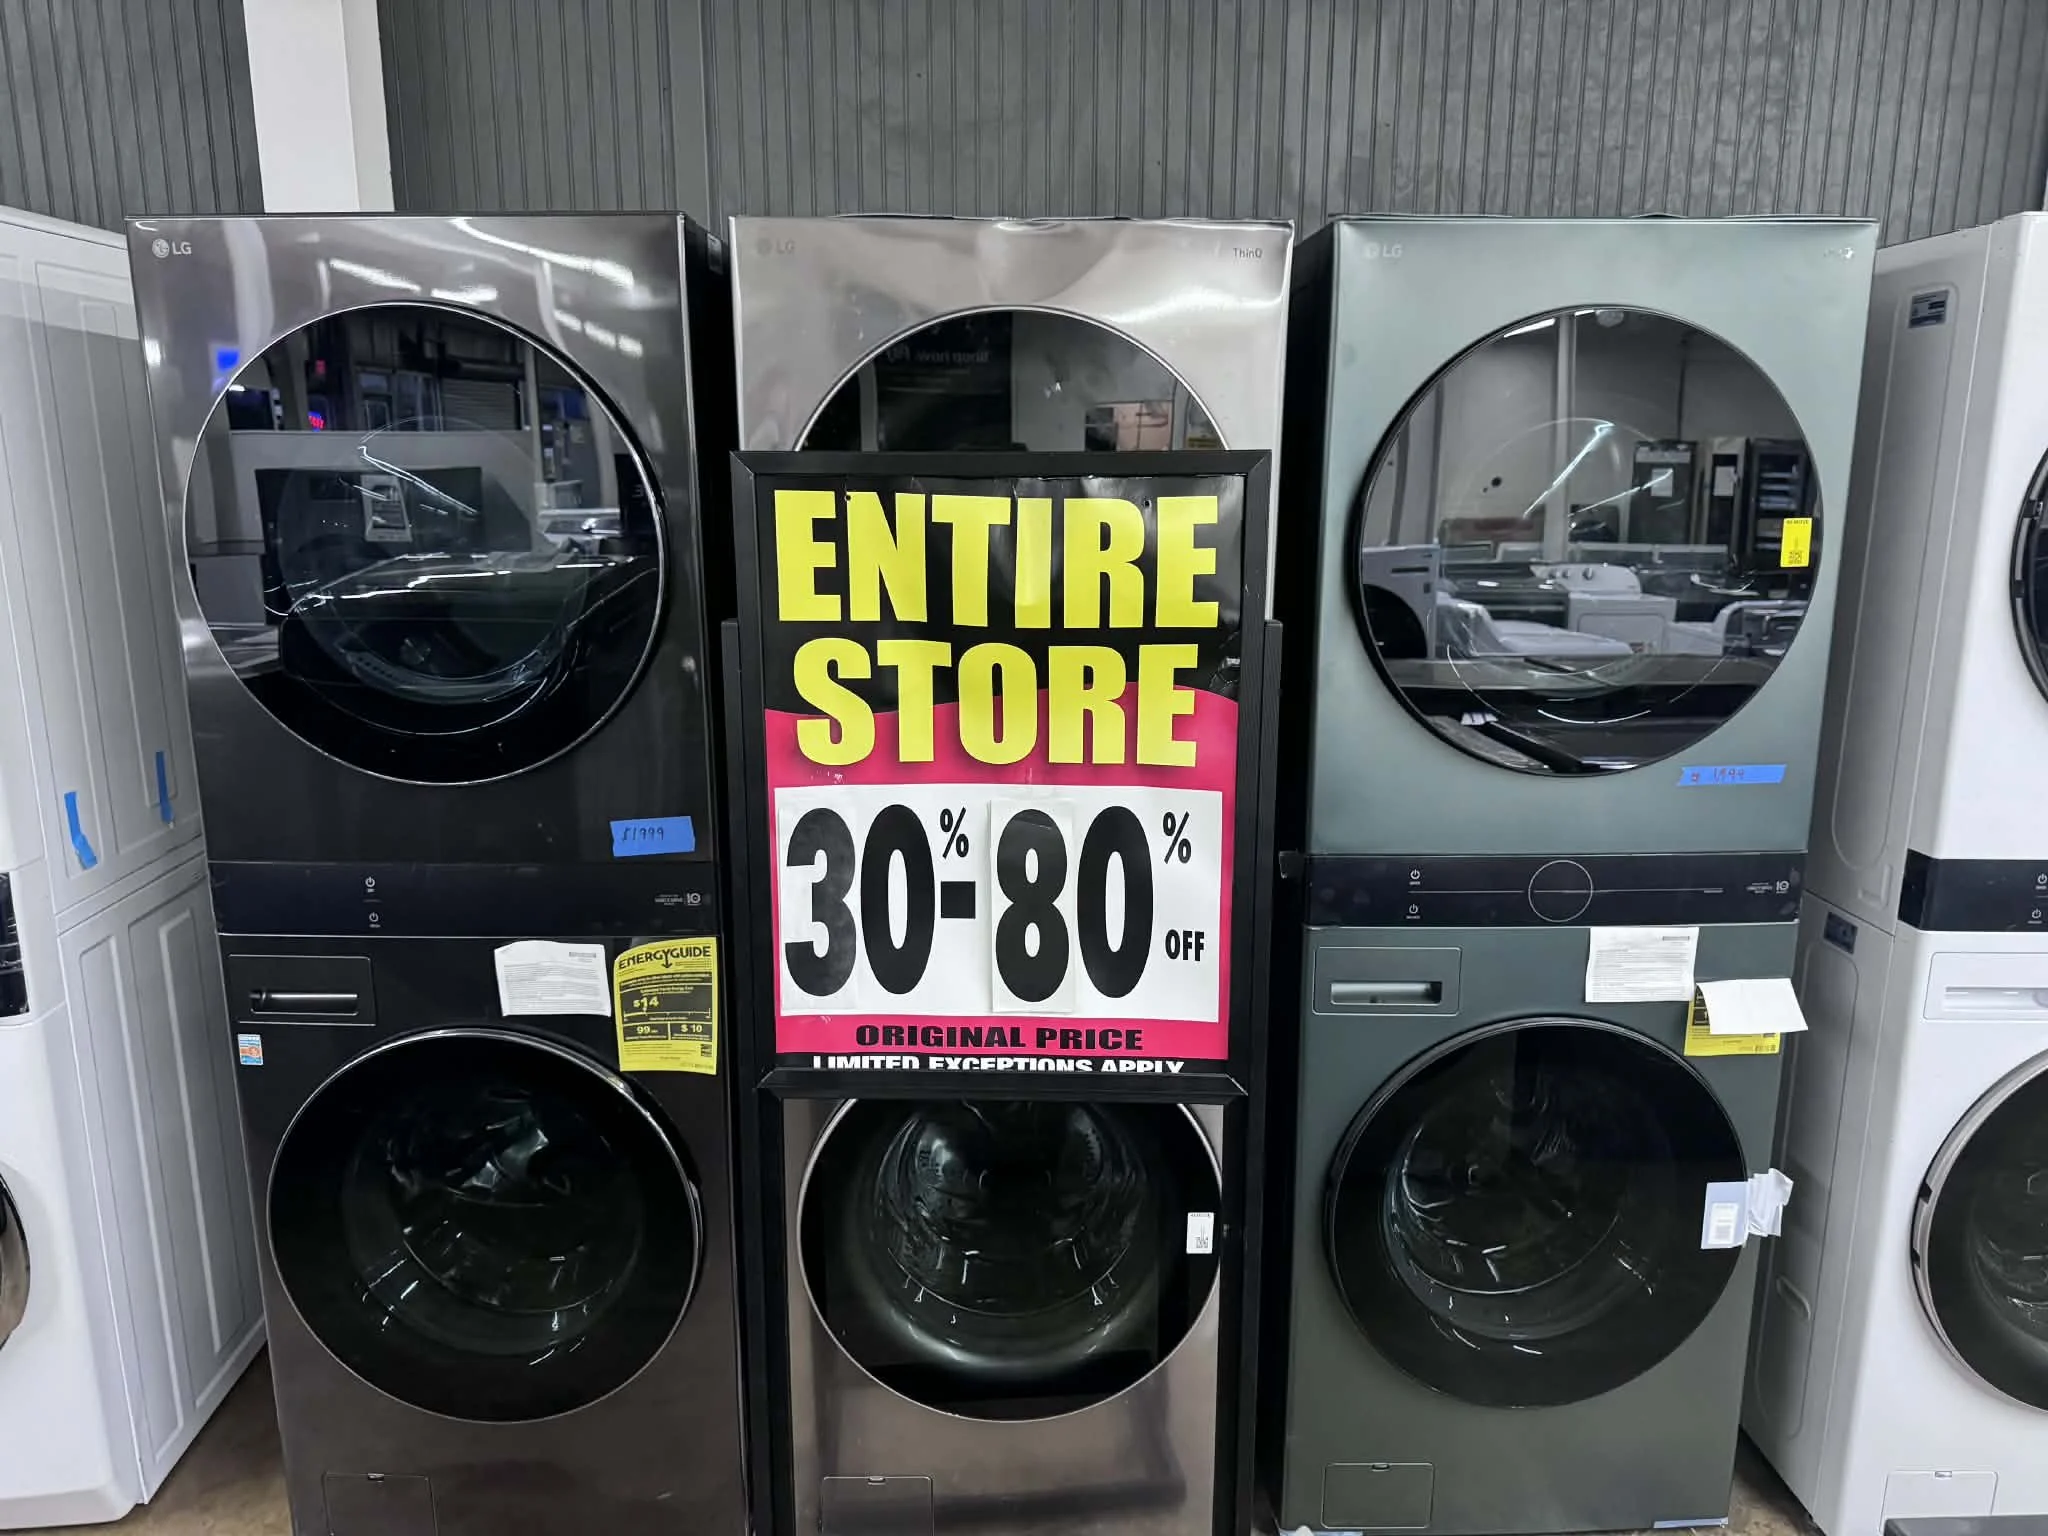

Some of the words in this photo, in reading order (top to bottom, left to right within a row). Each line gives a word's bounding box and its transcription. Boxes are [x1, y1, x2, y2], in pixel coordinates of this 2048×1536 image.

[172, 241, 192, 255] LG
[776, 240, 796, 254] LG
[1383, 244, 1402, 258] LG
[774, 490, 1219, 628] ENTIRE
[793, 637, 1198, 767] STORE
[618, 945, 711, 969] ENERGYGUIDE
[1165, 929, 1205, 961] OFF
[636, 1025, 650, 1034] 99
[856, 1025, 1026, 1048] ORIGINAL
[1036, 1028, 1143, 1050] PRICE
